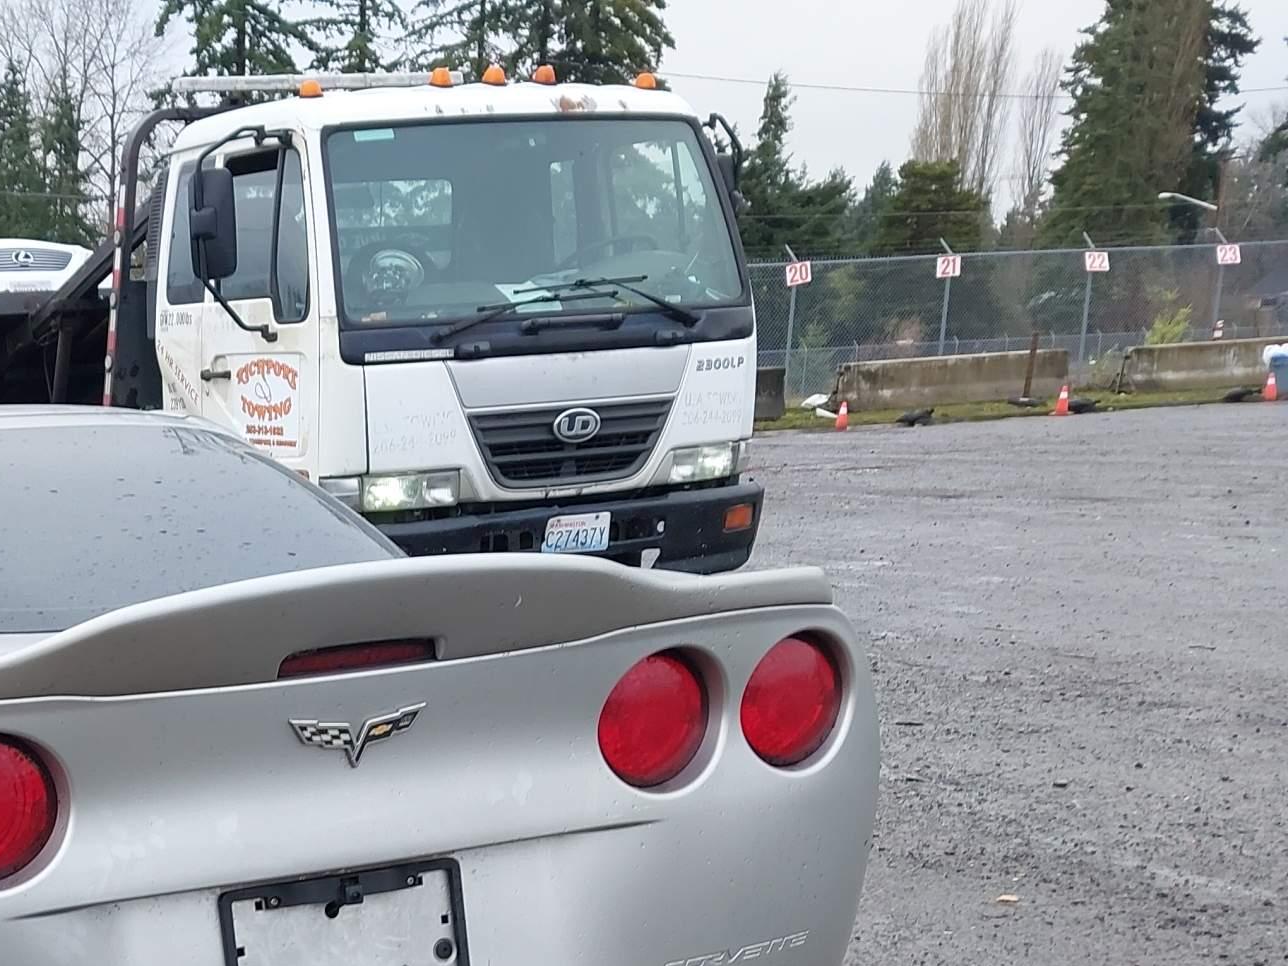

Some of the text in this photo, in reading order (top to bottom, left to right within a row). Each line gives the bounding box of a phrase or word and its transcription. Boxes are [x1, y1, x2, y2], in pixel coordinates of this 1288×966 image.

[1088, 253, 1107, 270] 22
[1219, 246, 1238, 262] 23
[789, 263, 809, 283] 20
[941, 257, 957, 276] 21
[696, 356, 745, 372] 2300LP
[164, 351, 174, 368] HR
[175, 365, 200, 406] SERVICE
[241, 395, 292, 421] TOWING
[560, 415, 596, 436] UD
[545, 526, 607, 551] C27437Y
